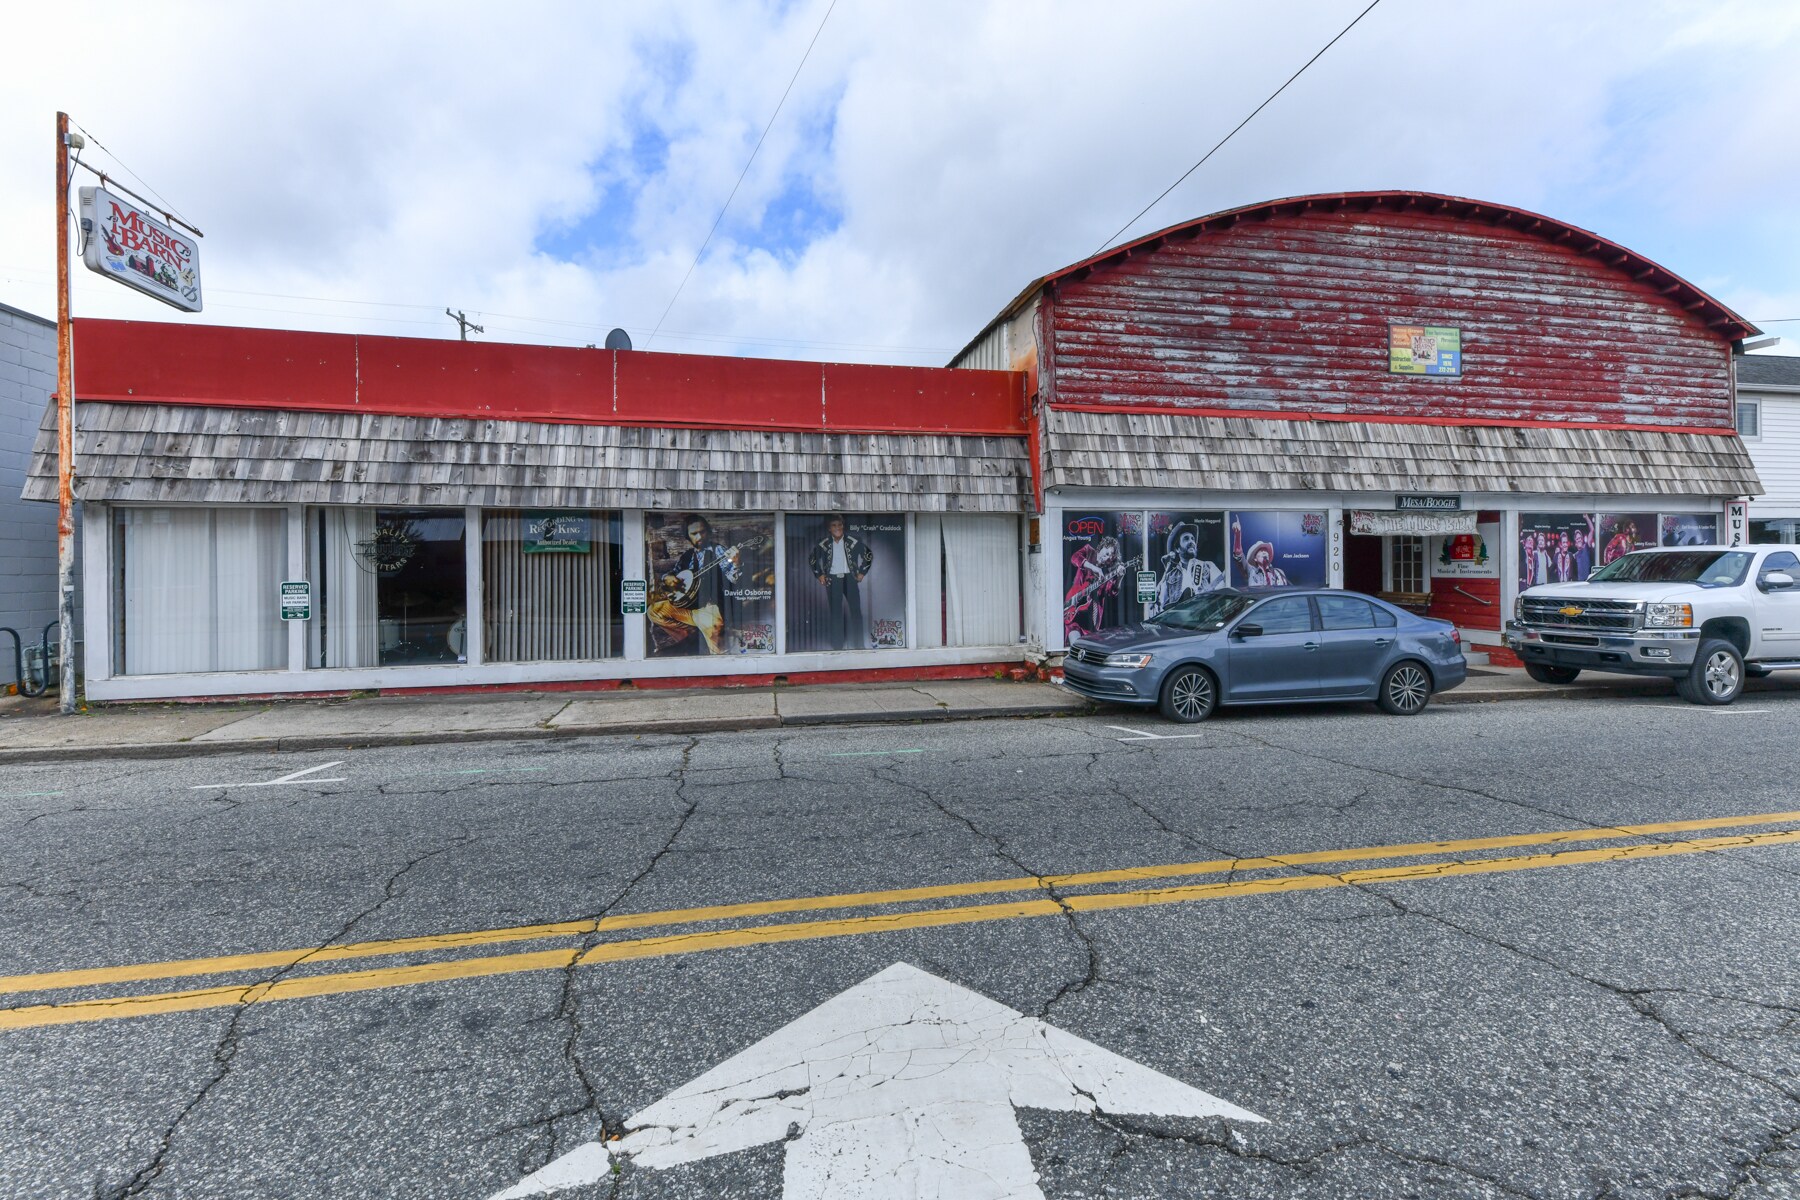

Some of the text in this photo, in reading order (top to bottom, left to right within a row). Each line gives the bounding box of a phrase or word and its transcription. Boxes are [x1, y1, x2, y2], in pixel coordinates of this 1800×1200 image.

[109, 201, 190, 263] MUSIC
[119, 226, 183, 271] BARN
[558, 523, 580, 533] KING
[1069, 520, 1104, 534] OPEN
[1444, 516, 1474, 531] BARN
